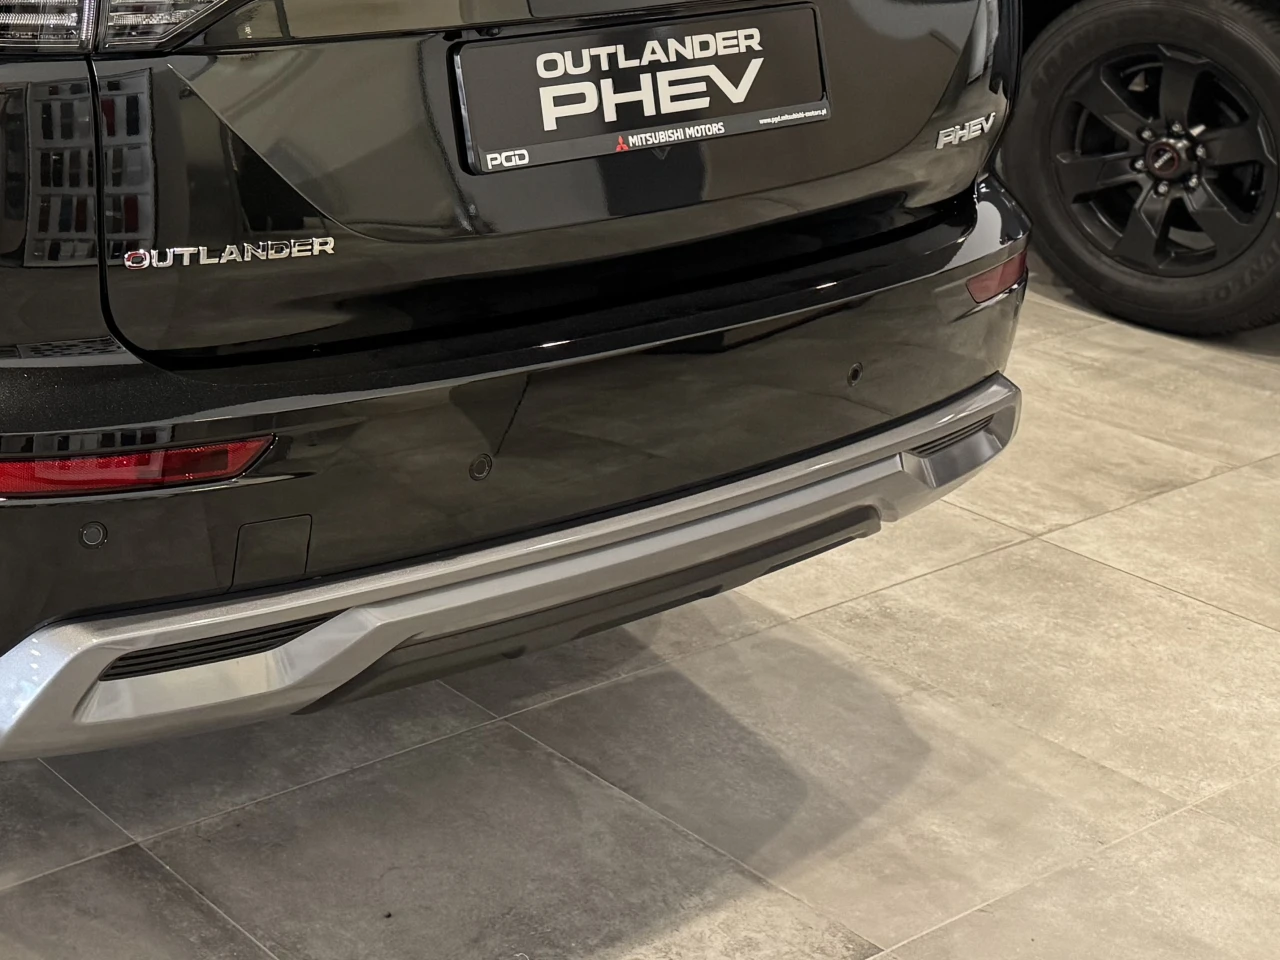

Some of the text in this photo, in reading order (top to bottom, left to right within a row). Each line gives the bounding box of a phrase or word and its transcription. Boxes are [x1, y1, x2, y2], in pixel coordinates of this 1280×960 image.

[536, 27, 763, 79] OUTLANDER
[539, 57, 764, 132] PHEV
[628, 121, 726, 147] MITSUBISHI MOTORS
[935, 112, 996, 150] PHEV
[486, 149, 530, 170] PGD
[124, 237, 335, 270] OUTLANDER
